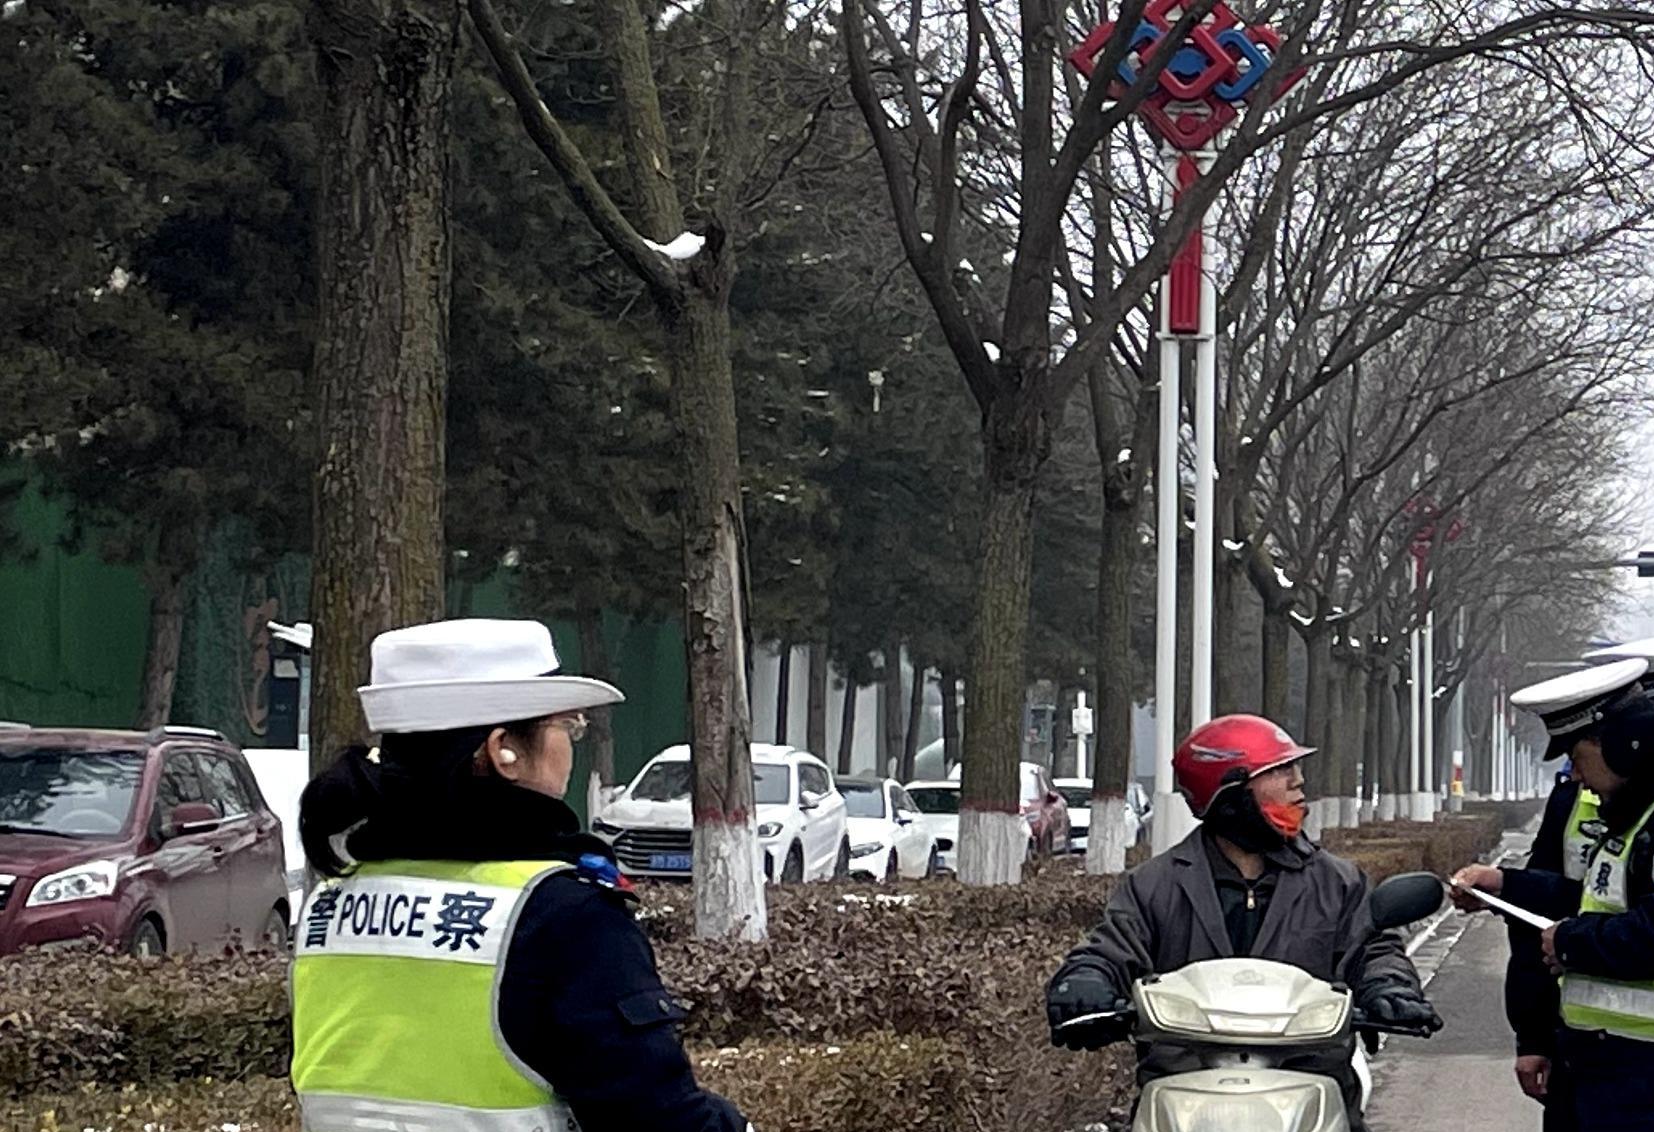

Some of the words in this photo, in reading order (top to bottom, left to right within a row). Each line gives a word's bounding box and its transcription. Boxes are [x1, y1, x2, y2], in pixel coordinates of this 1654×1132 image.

[305, 886, 343, 949] 警
[336, 892, 432, 938] POLICE
[431, 890, 497, 952] 察
